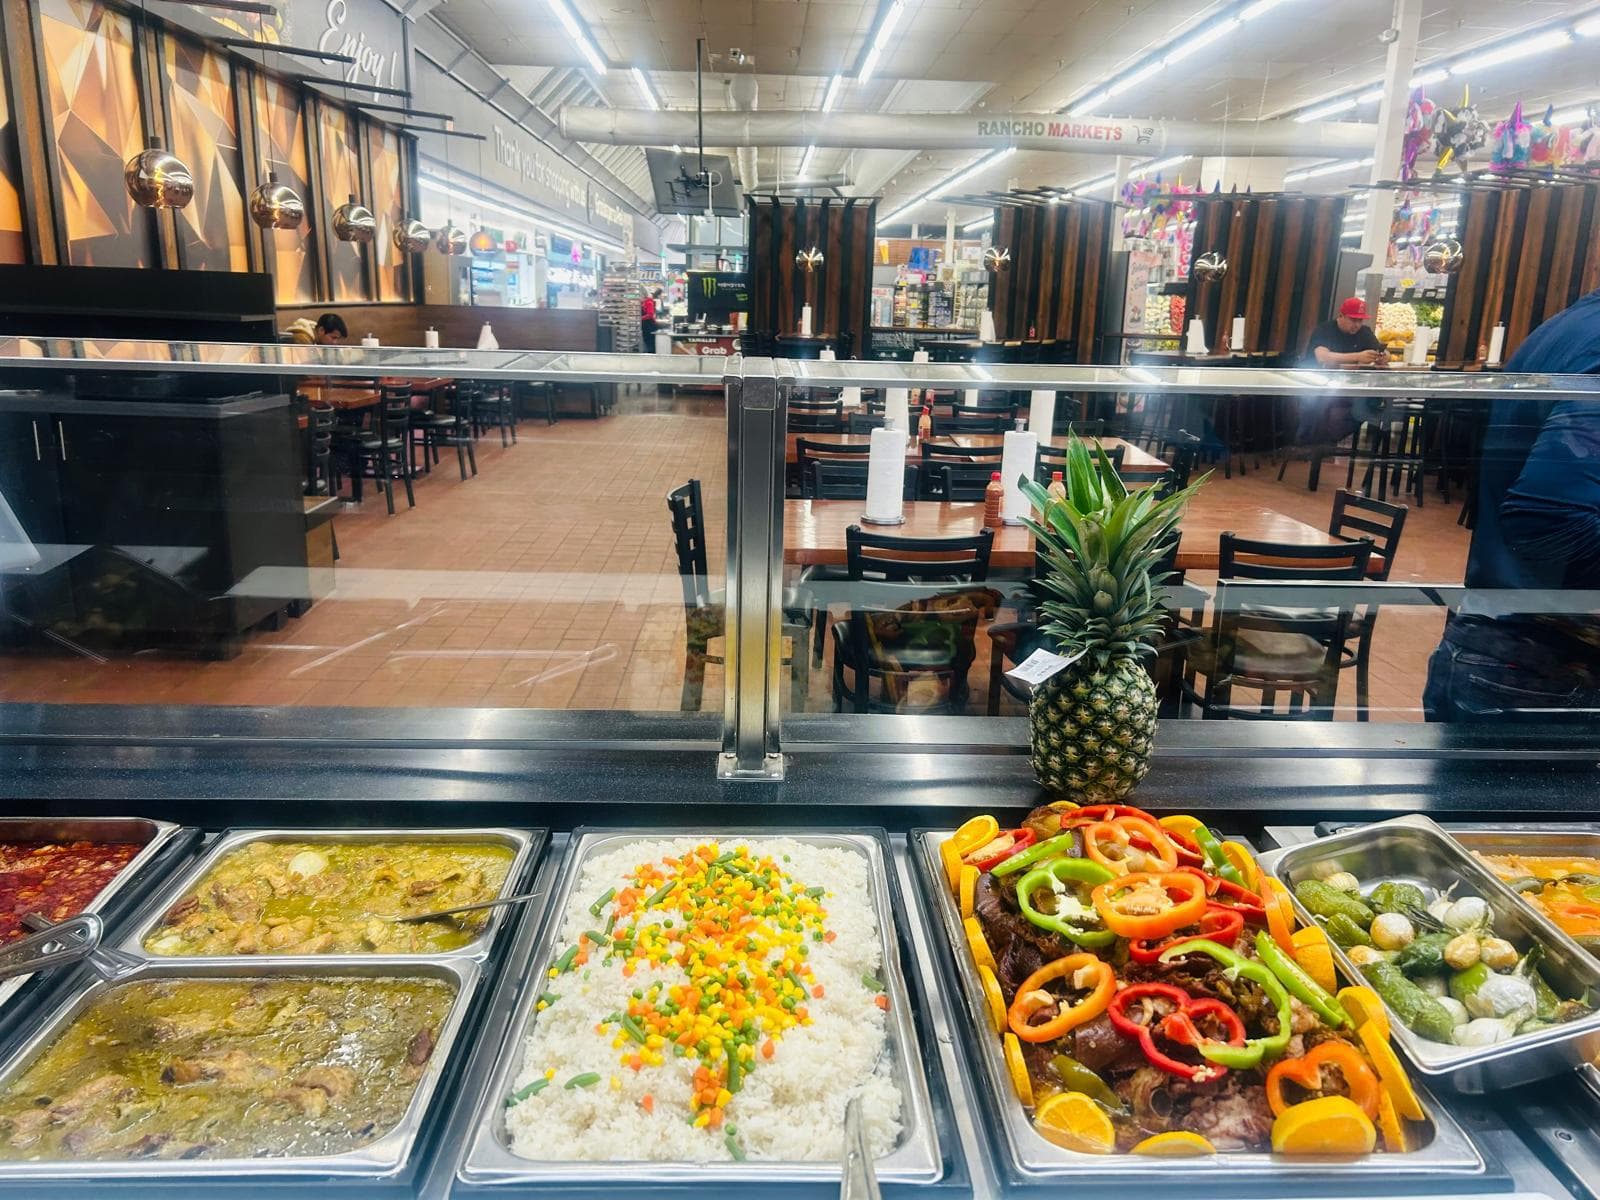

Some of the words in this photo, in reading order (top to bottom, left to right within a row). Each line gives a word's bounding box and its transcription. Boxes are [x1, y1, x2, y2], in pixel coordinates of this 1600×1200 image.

[977, 121, 1045, 136] RANCHO
[1047, 122, 1123, 141] MARKETS
[493, 124, 521, 173] Thank
[520, 151, 535, 184] you
[701, 346, 727, 356] Grab
